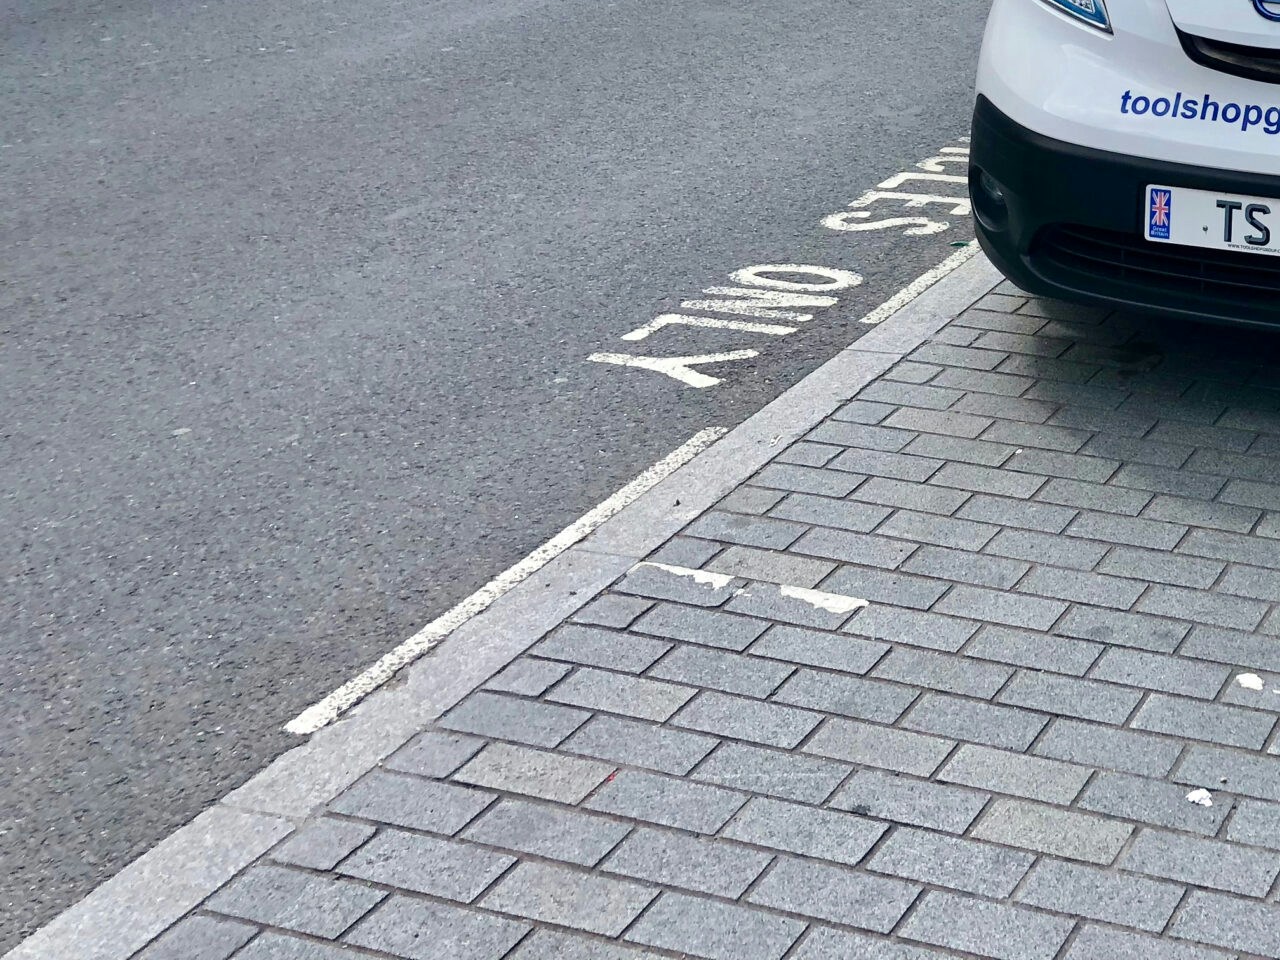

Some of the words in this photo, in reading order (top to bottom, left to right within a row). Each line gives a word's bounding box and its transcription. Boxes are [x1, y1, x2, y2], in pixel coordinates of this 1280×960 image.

[1150, 230, 1169, 238] Britain
[1152, 225, 1168, 233] Great
[1216, 199, 1272, 246] TS
[586, 263, 864, 389] ONLY
